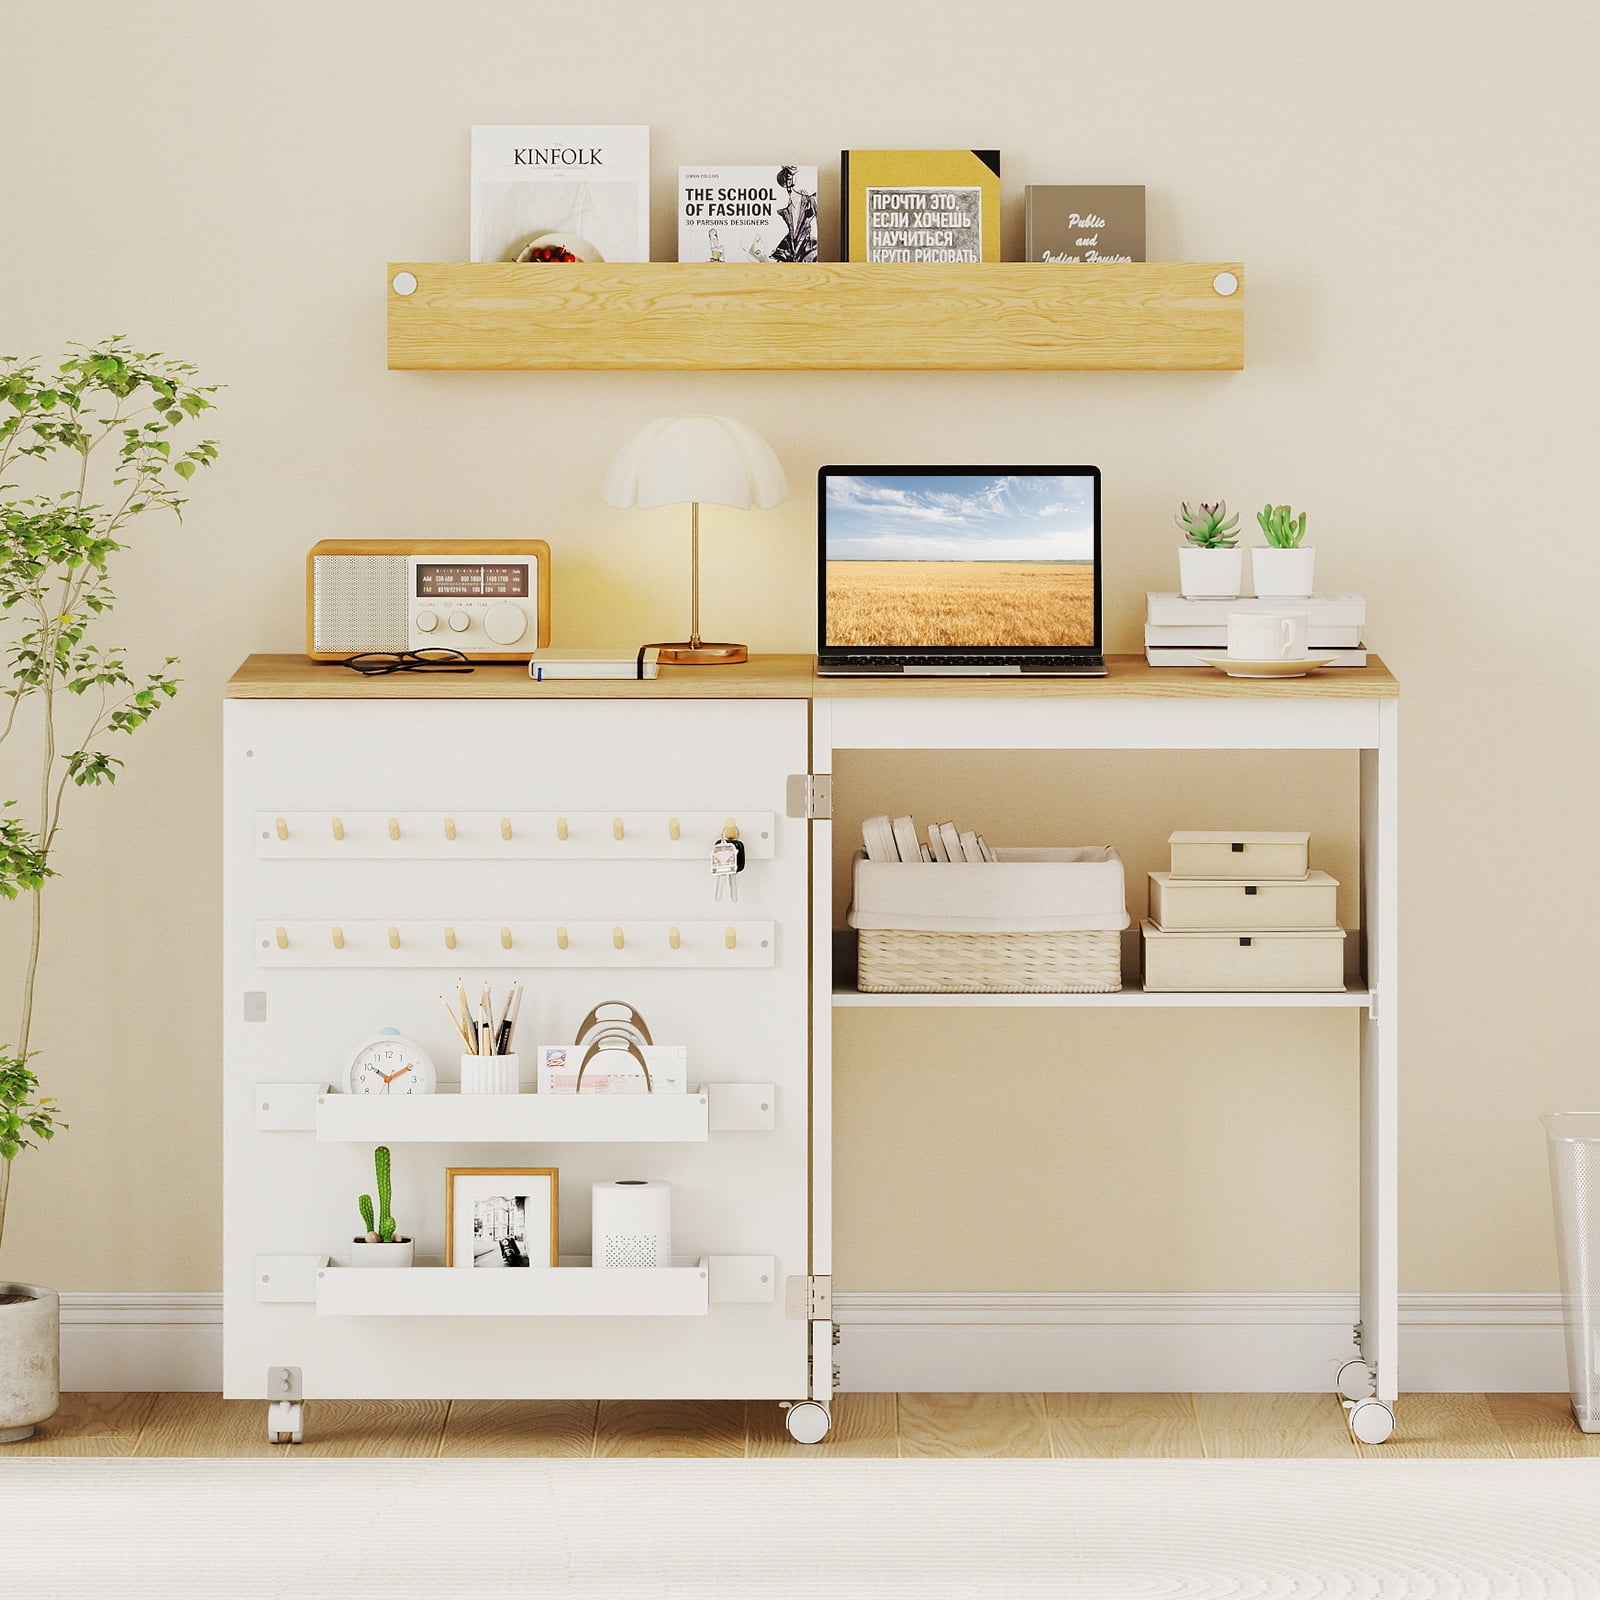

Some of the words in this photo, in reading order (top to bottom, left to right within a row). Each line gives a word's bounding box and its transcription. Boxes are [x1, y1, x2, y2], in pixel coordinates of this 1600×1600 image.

[514, 148, 603, 165] KINFOLK
[685, 188, 714, 201] THE
[718, 188, 777, 201] SCHOOL
[872, 194, 926, 210] ПРОЧТИ
[930, 194, 960, 211] ЭТО,
[685, 203, 705, 216] OF
[708, 203, 772, 217] FASHION
[872, 212, 909, 228] ЕСЛИ
[913, 212, 971, 228] ХОЧЕШЬ
[1068, 213, 1106, 229] Public
[872, 230, 953, 246] НАУЧИТЬСЯ
[1075, 233, 1099, 247] and
[872, 249, 910, 263] КРУТО
[915, 249, 977, 263] РИСОВАТЬ
[1042, 249, 1081, 263] Indian
[374, 1054, 381, 1062] 11
[385, 1050, 394, 1059] 12
[399, 1054, 403, 1062] 1
[364, 1063, 373, 1071] 10
[359, 1075, 366, 1083] 9
[411, 1075, 418, 1084] 3
